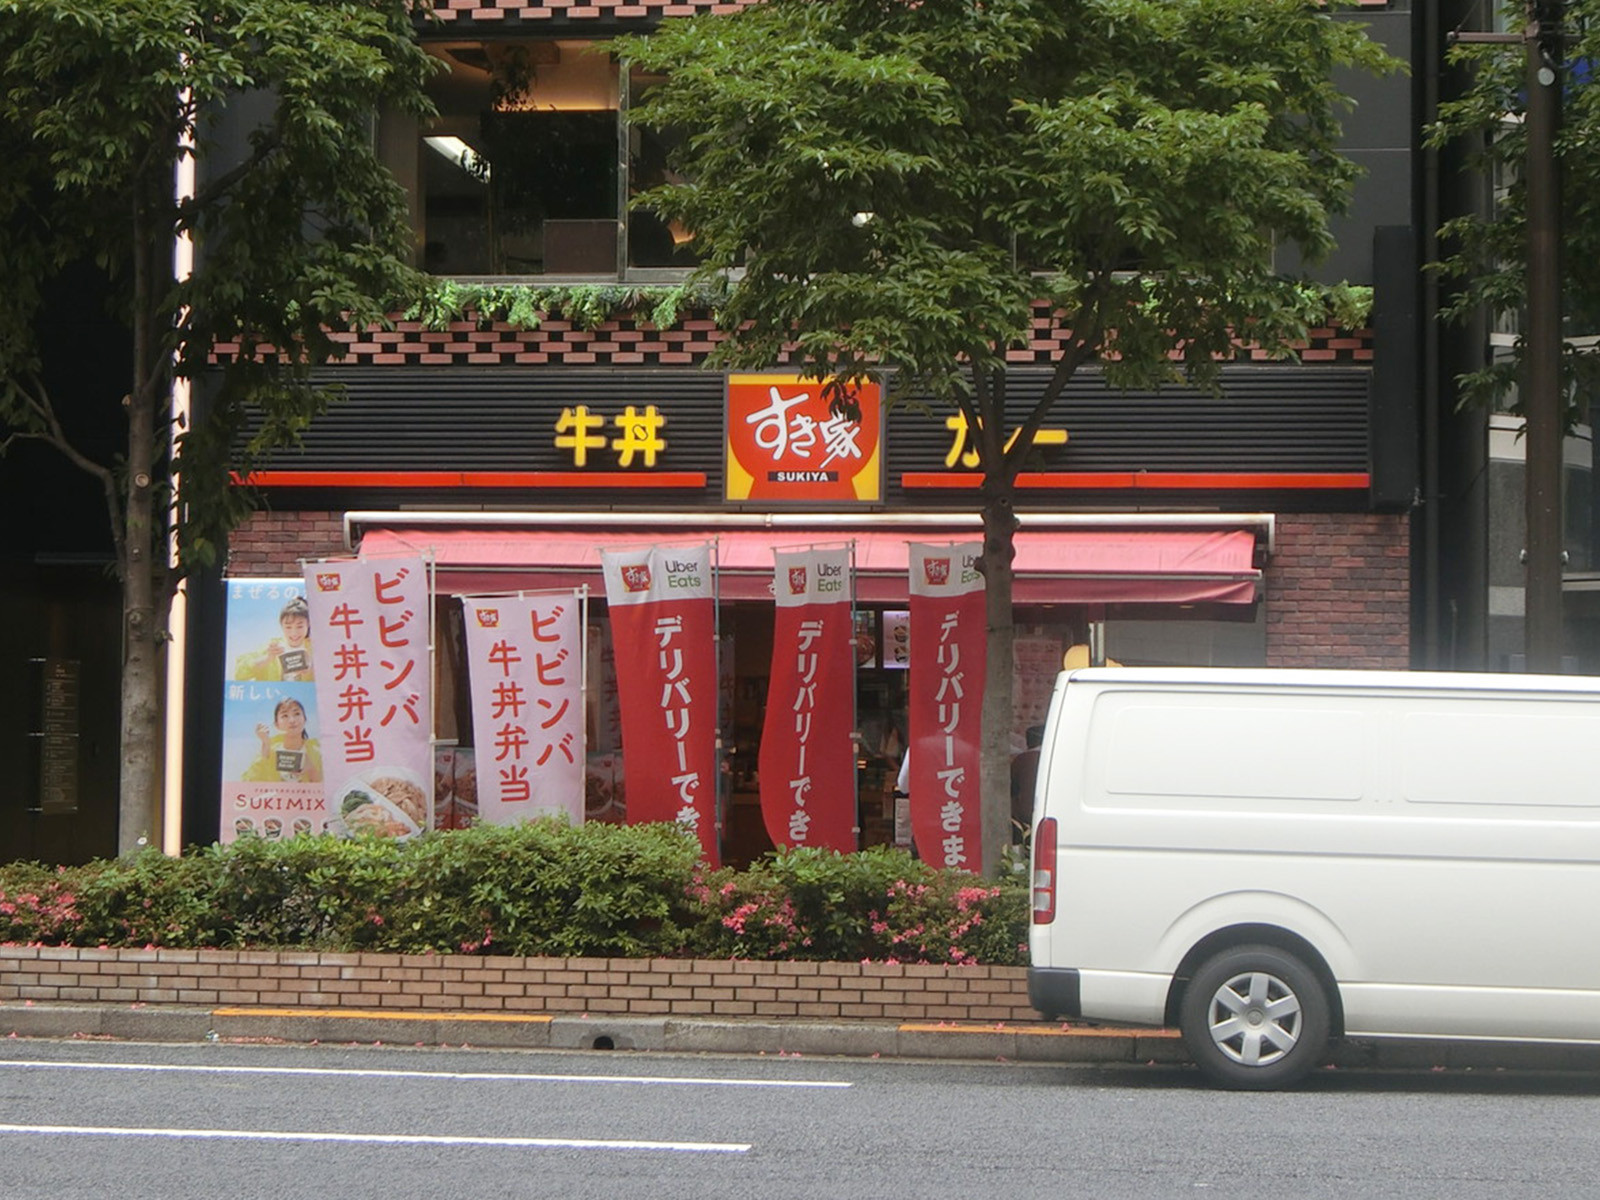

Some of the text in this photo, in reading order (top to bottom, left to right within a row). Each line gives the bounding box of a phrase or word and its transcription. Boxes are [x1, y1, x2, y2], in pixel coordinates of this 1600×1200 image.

[554, 405, 665, 467] 牛丼
[746, 386, 862, 469] すき家
[944, 407, 1069, 468] カー
[777, 471, 829, 482] SUKIYA
[231, 583, 307, 600] まぜるの
[665, 560, 698, 573] Uber
[668, 575, 701, 588] Eats
[329, 603, 375, 763] 牛丼弁当
[374, 567, 420, 727] ビビンバ
[488, 639, 530, 802] 牛丼弁当
[531, 605, 574, 767] ビビンバ
[789, 620, 824, 848] デリバリーでき
[935, 610, 970, 874] デリバリーできま
[235, 793, 326, 811] SUKIMIX
